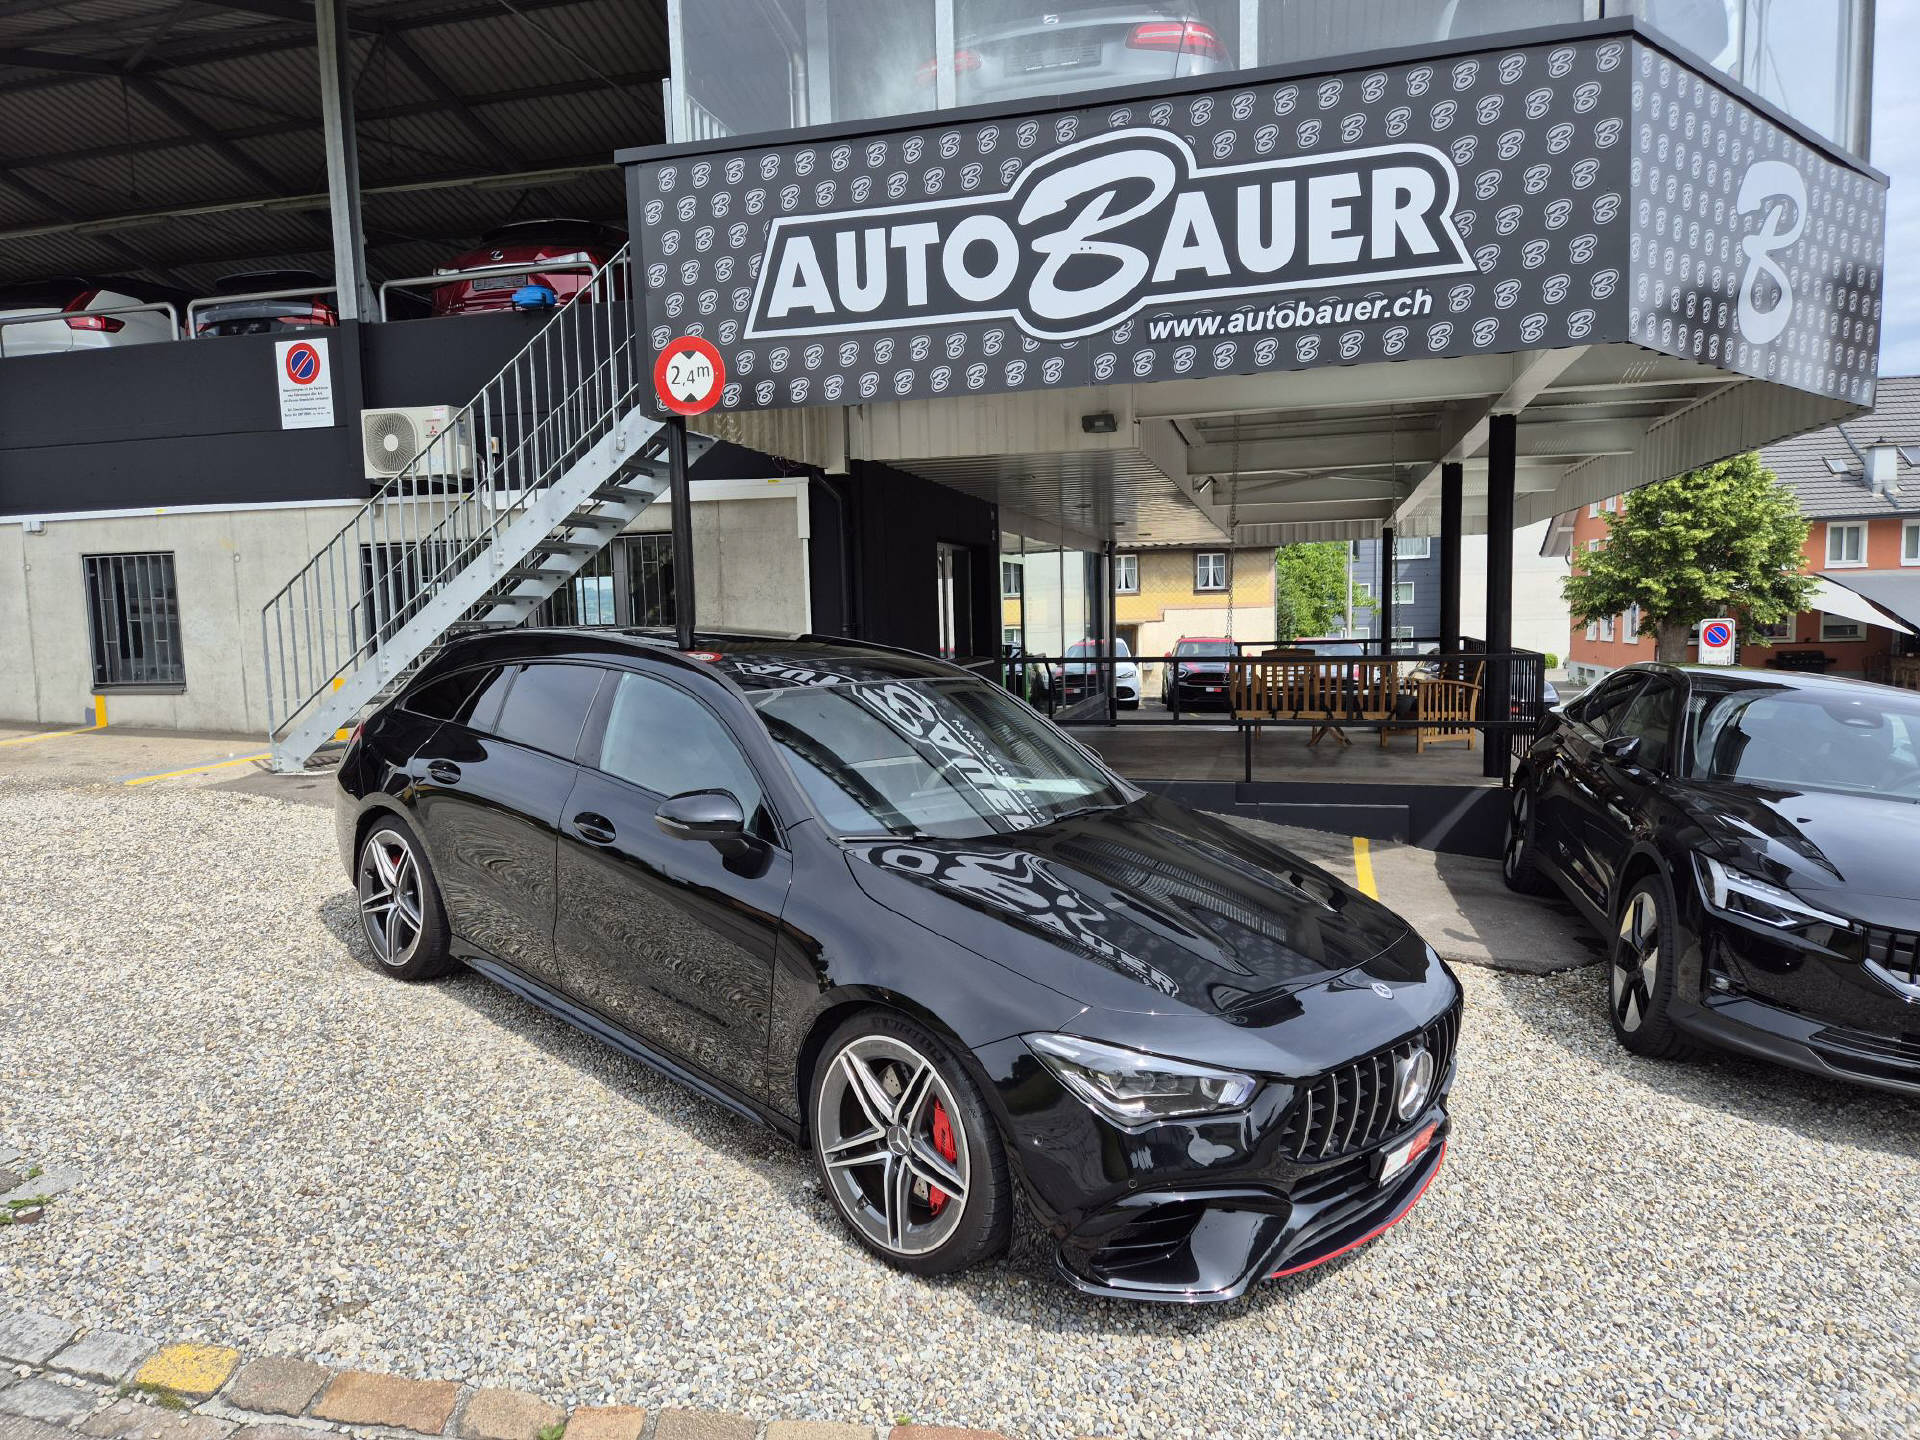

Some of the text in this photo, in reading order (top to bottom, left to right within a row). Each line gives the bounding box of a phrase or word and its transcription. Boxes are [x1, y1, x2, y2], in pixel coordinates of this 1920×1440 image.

[767, 150, 1441, 320] AUTO BAUER
[1149, 291, 1432, 340] www.autobauer.ch
